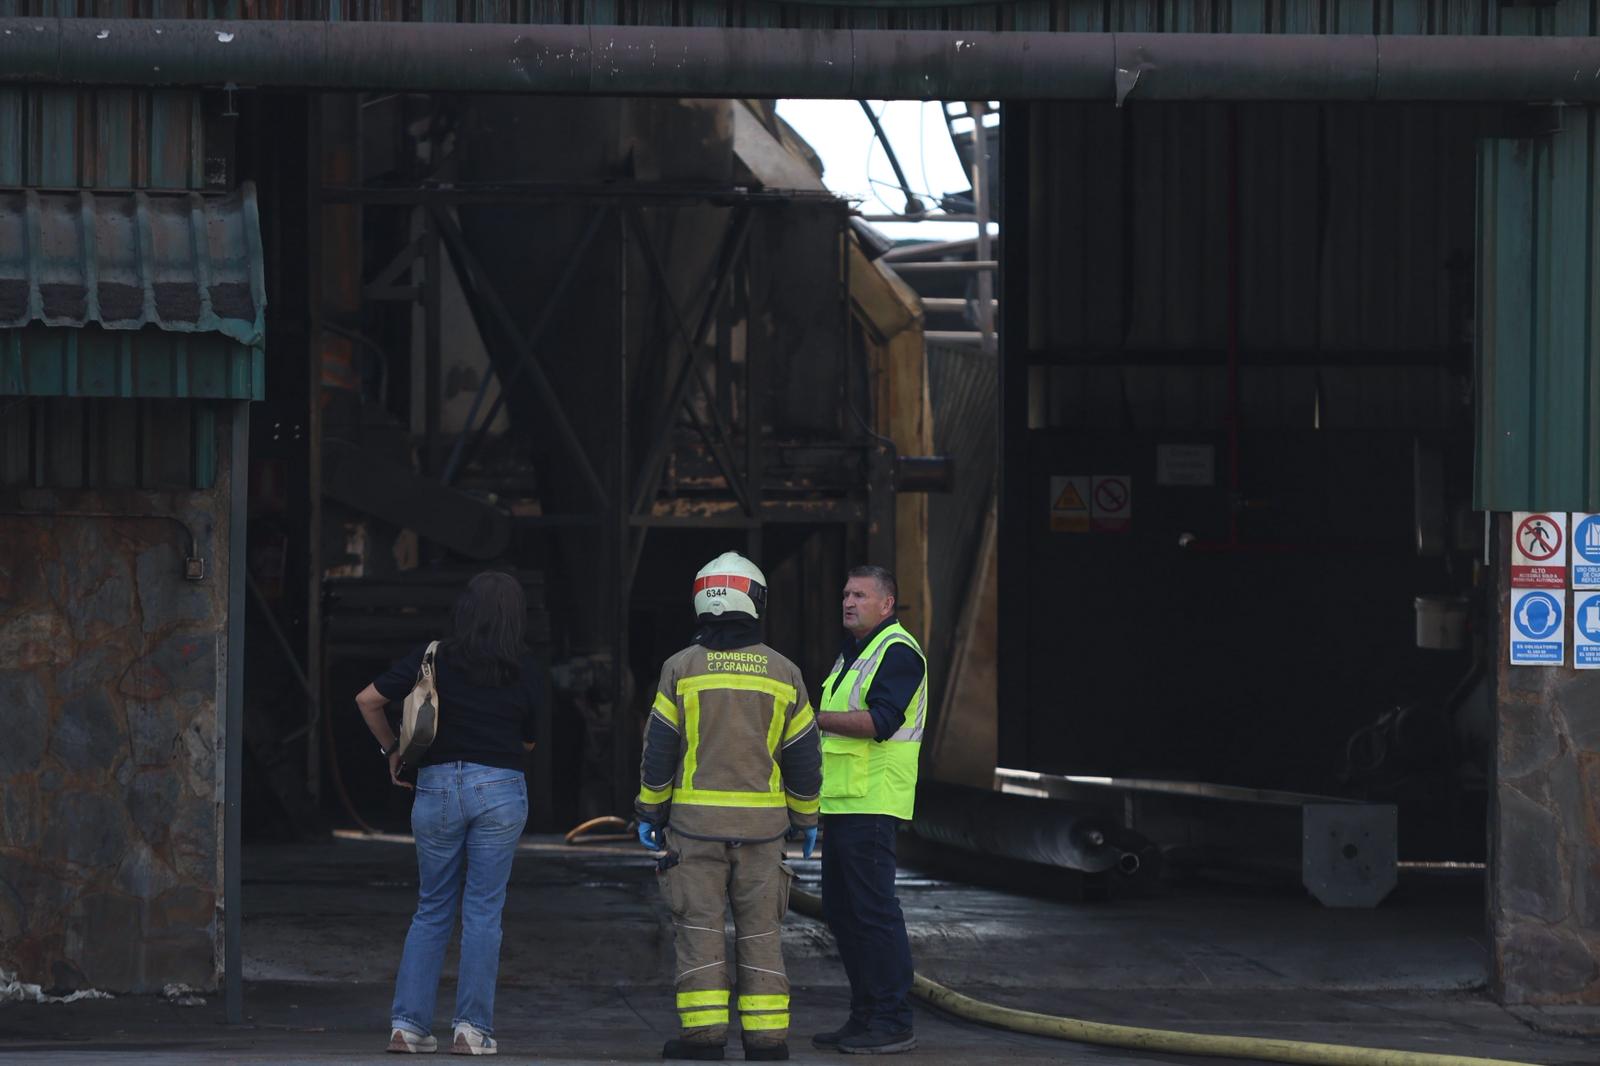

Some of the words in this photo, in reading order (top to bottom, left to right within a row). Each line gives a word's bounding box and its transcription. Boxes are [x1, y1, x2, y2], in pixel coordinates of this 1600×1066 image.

[706, 588, 727, 598] 6344
[707, 651, 768, 664] BOMBEROS
[707, 661, 768, 674] C.P.GRANADA
